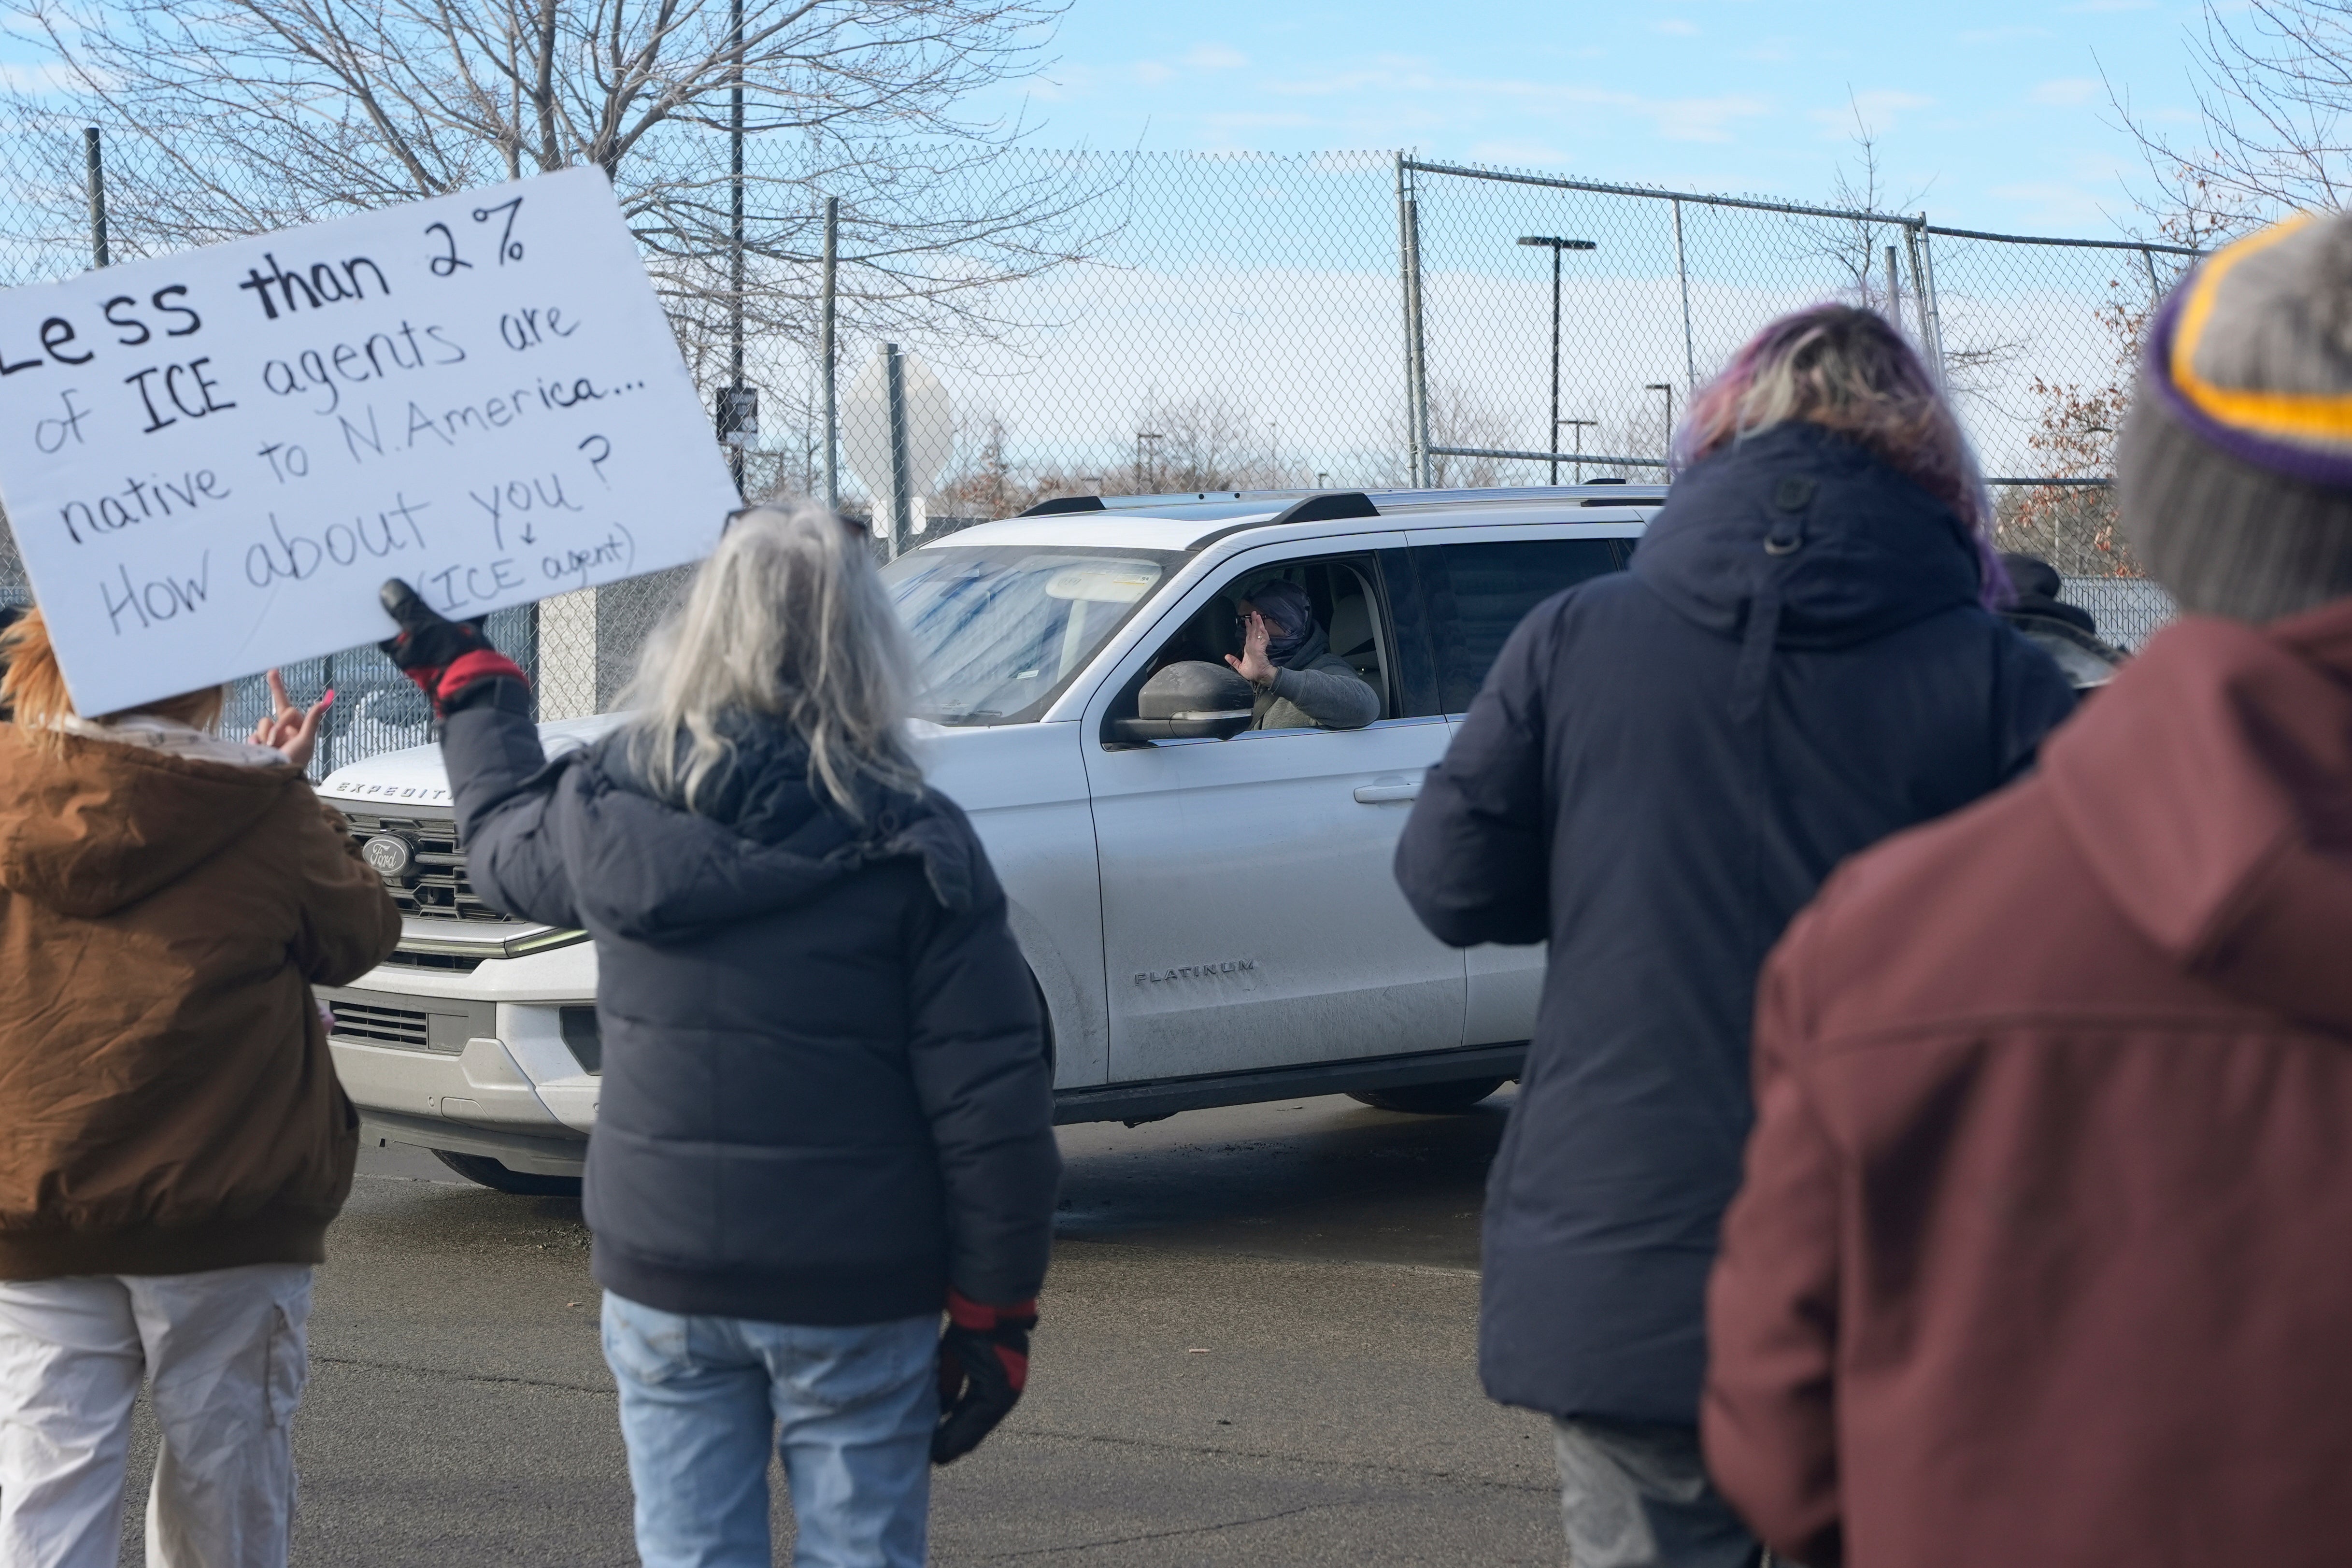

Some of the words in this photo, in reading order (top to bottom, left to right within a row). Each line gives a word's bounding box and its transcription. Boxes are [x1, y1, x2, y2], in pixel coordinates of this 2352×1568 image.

[0, 284, 202, 376] Less
[238, 252, 390, 320] than
[425, 195, 524, 277] 2%
[35, 388, 92, 454] of
[124, 356, 237, 434] ICE
[263, 320, 466, 415] agents
[500, 307, 582, 351] are
[59, 470, 231, 544] native
[257, 441, 309, 484] to
[100, 549, 210, 635] How
[246, 492, 431, 588] about
[416, 558, 526, 613] (ICE
[542, 521, 635, 588] agent)
[370, 843, 397, 869] Ford
[1135, 959, 1254, 984] PLATINUM
